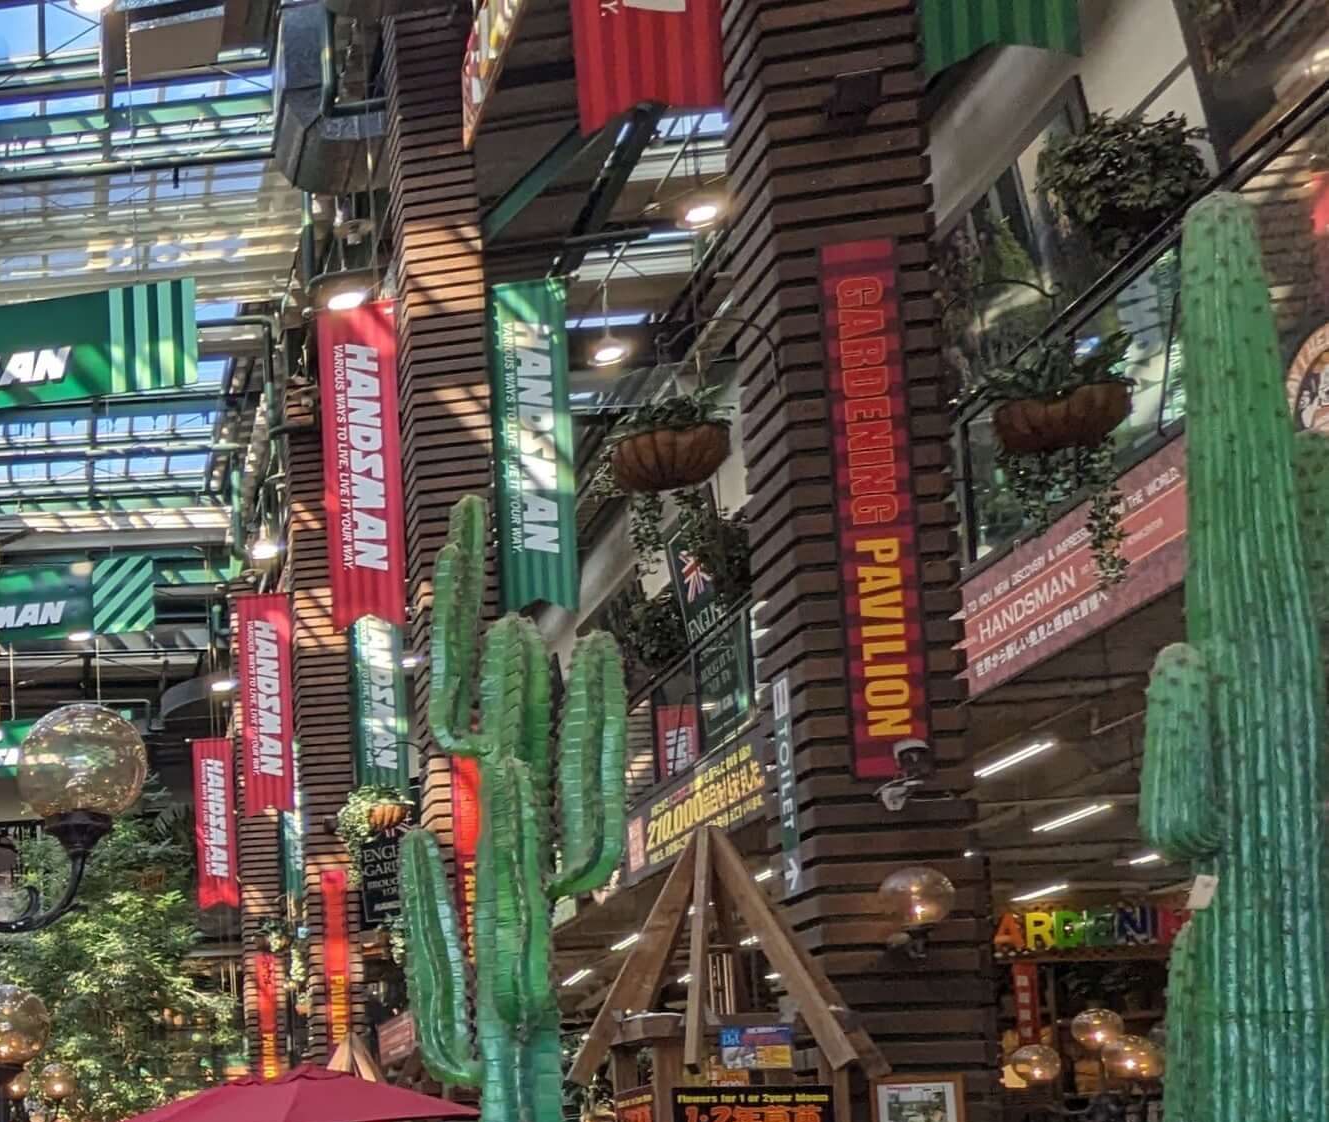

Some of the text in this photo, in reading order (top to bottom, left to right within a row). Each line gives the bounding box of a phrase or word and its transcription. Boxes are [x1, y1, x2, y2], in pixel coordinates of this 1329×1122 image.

[334, 344, 354, 570] VARIOUS WAYS TO LIVE, LIVE IT YOUR WAY.
[345, 344, 388, 571] HANDSMAN
[514, 322, 559, 554] HANDSMAN
[836, 275, 912, 738] GARDENING PAVILION
[978, 566, 1076, 642] HANDSMAN
[254, 620, 283, 777] HANDSMAN
[777, 724, 795, 829] TOILET
[207, 759, 229, 877] HANDSMAN
[329, 975, 348, 1044] PAVILIO
